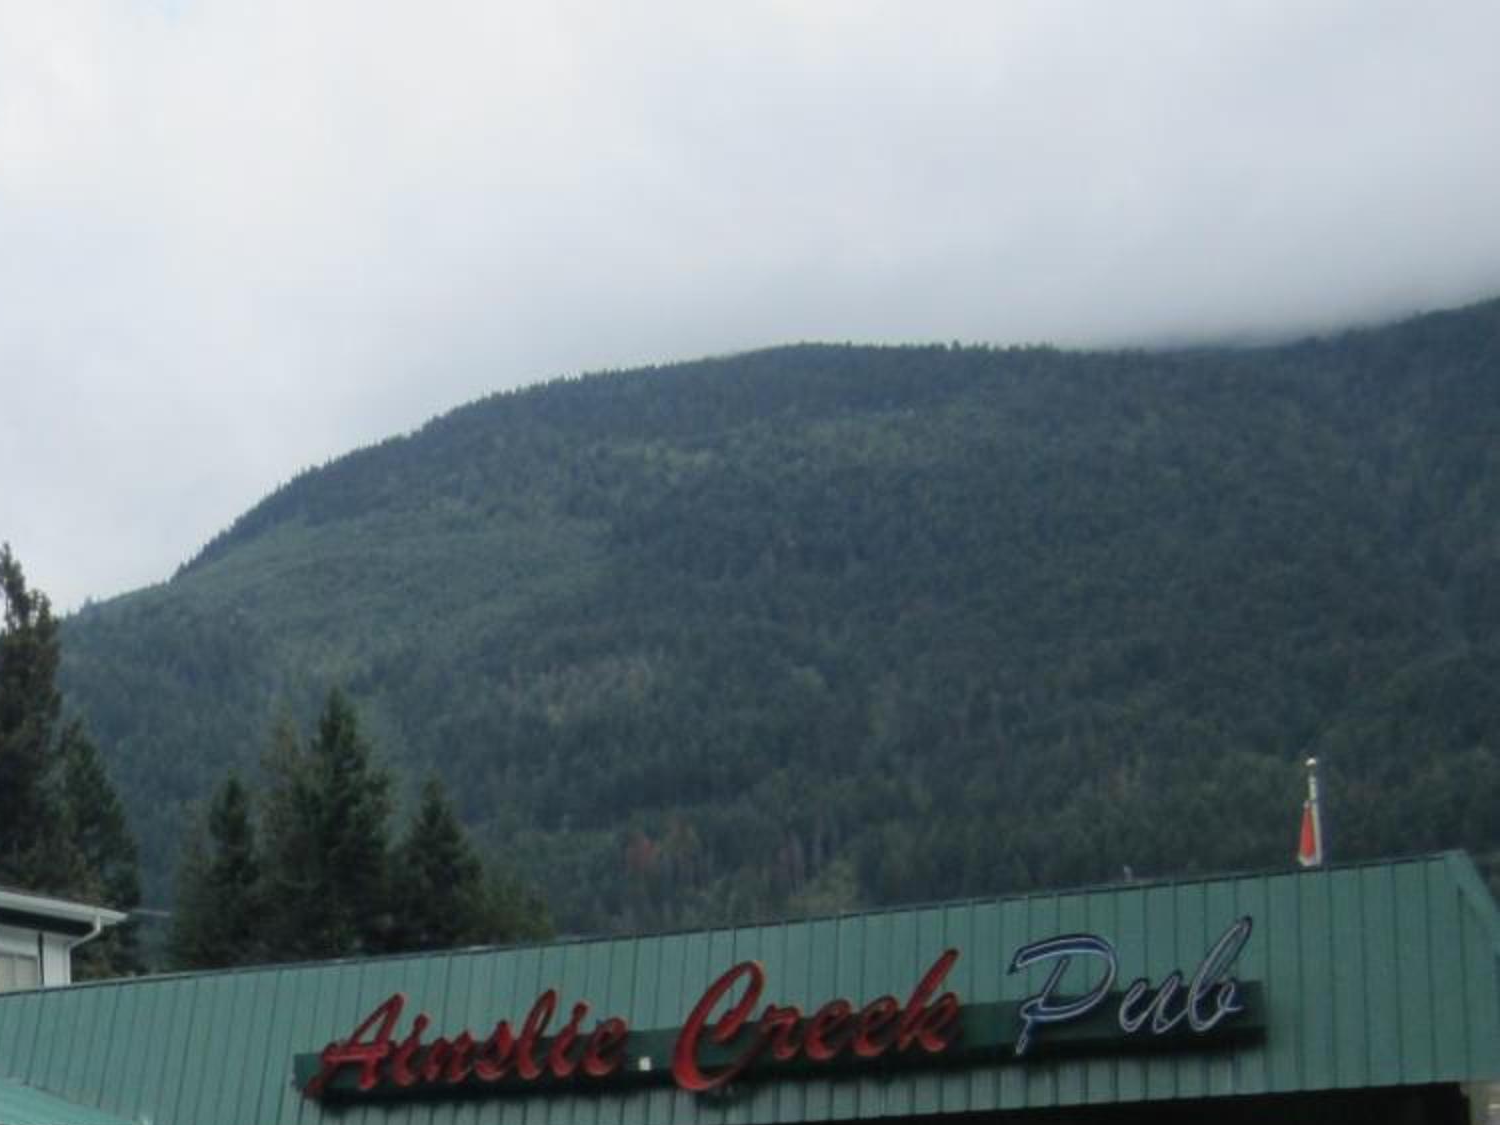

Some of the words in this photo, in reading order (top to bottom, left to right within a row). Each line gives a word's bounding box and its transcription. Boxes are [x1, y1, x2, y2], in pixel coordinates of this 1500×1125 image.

[303, 989, 628, 1095] Ainslie
[673, 948, 961, 1092] Creek
[1008, 916, 1252, 1055] Pub
